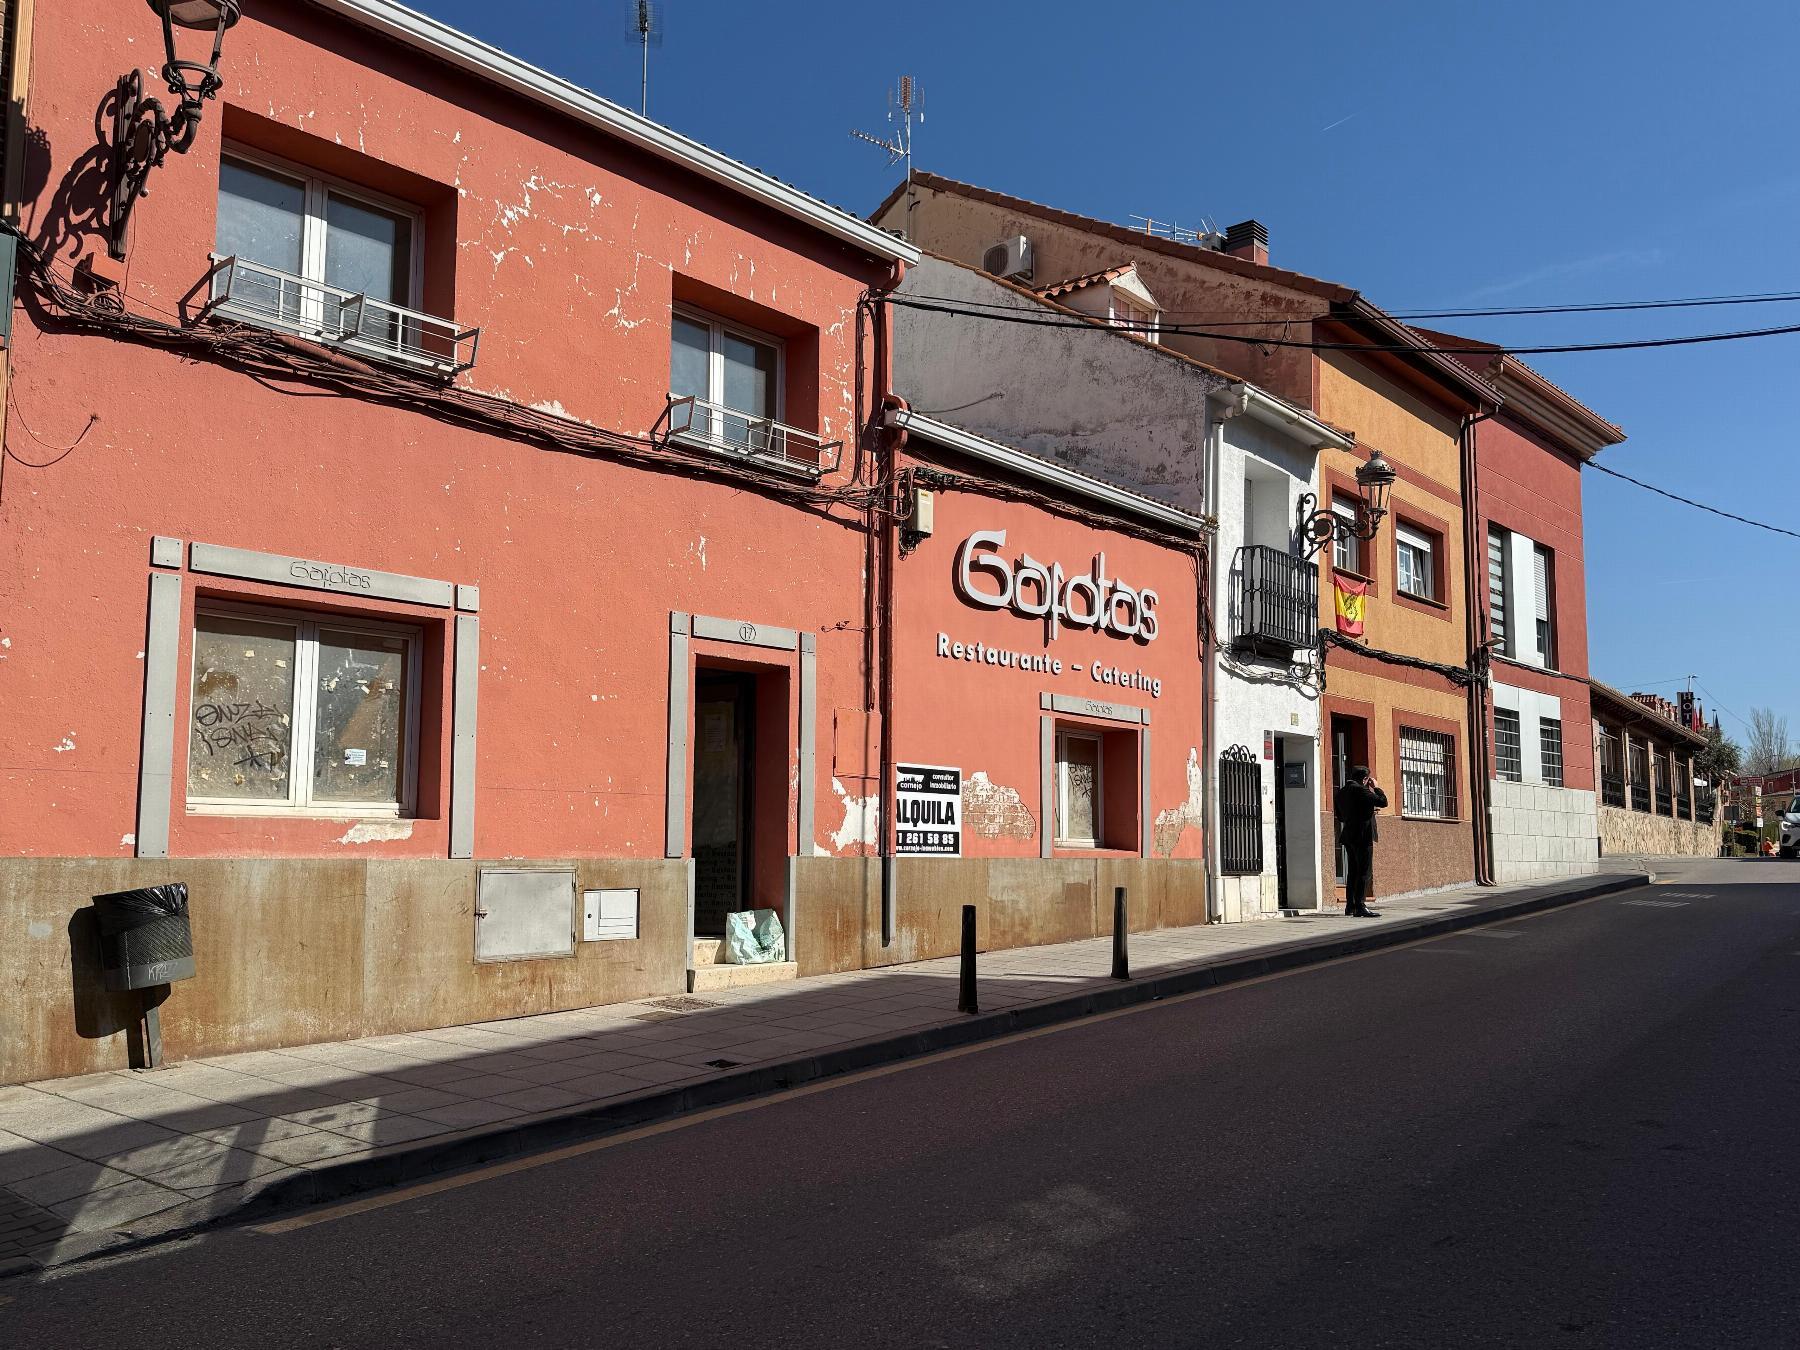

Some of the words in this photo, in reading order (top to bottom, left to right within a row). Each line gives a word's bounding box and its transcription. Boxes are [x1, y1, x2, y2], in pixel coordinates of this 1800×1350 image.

[938, 632, 1062, 674] Restaurante
[1092, 660, 1162, 697] Catering
[900, 782, 923, 790] cornejo
[906, 833, 924, 845] 261
[927, 833, 939, 845] 58
[942, 833, 954, 845] 85
